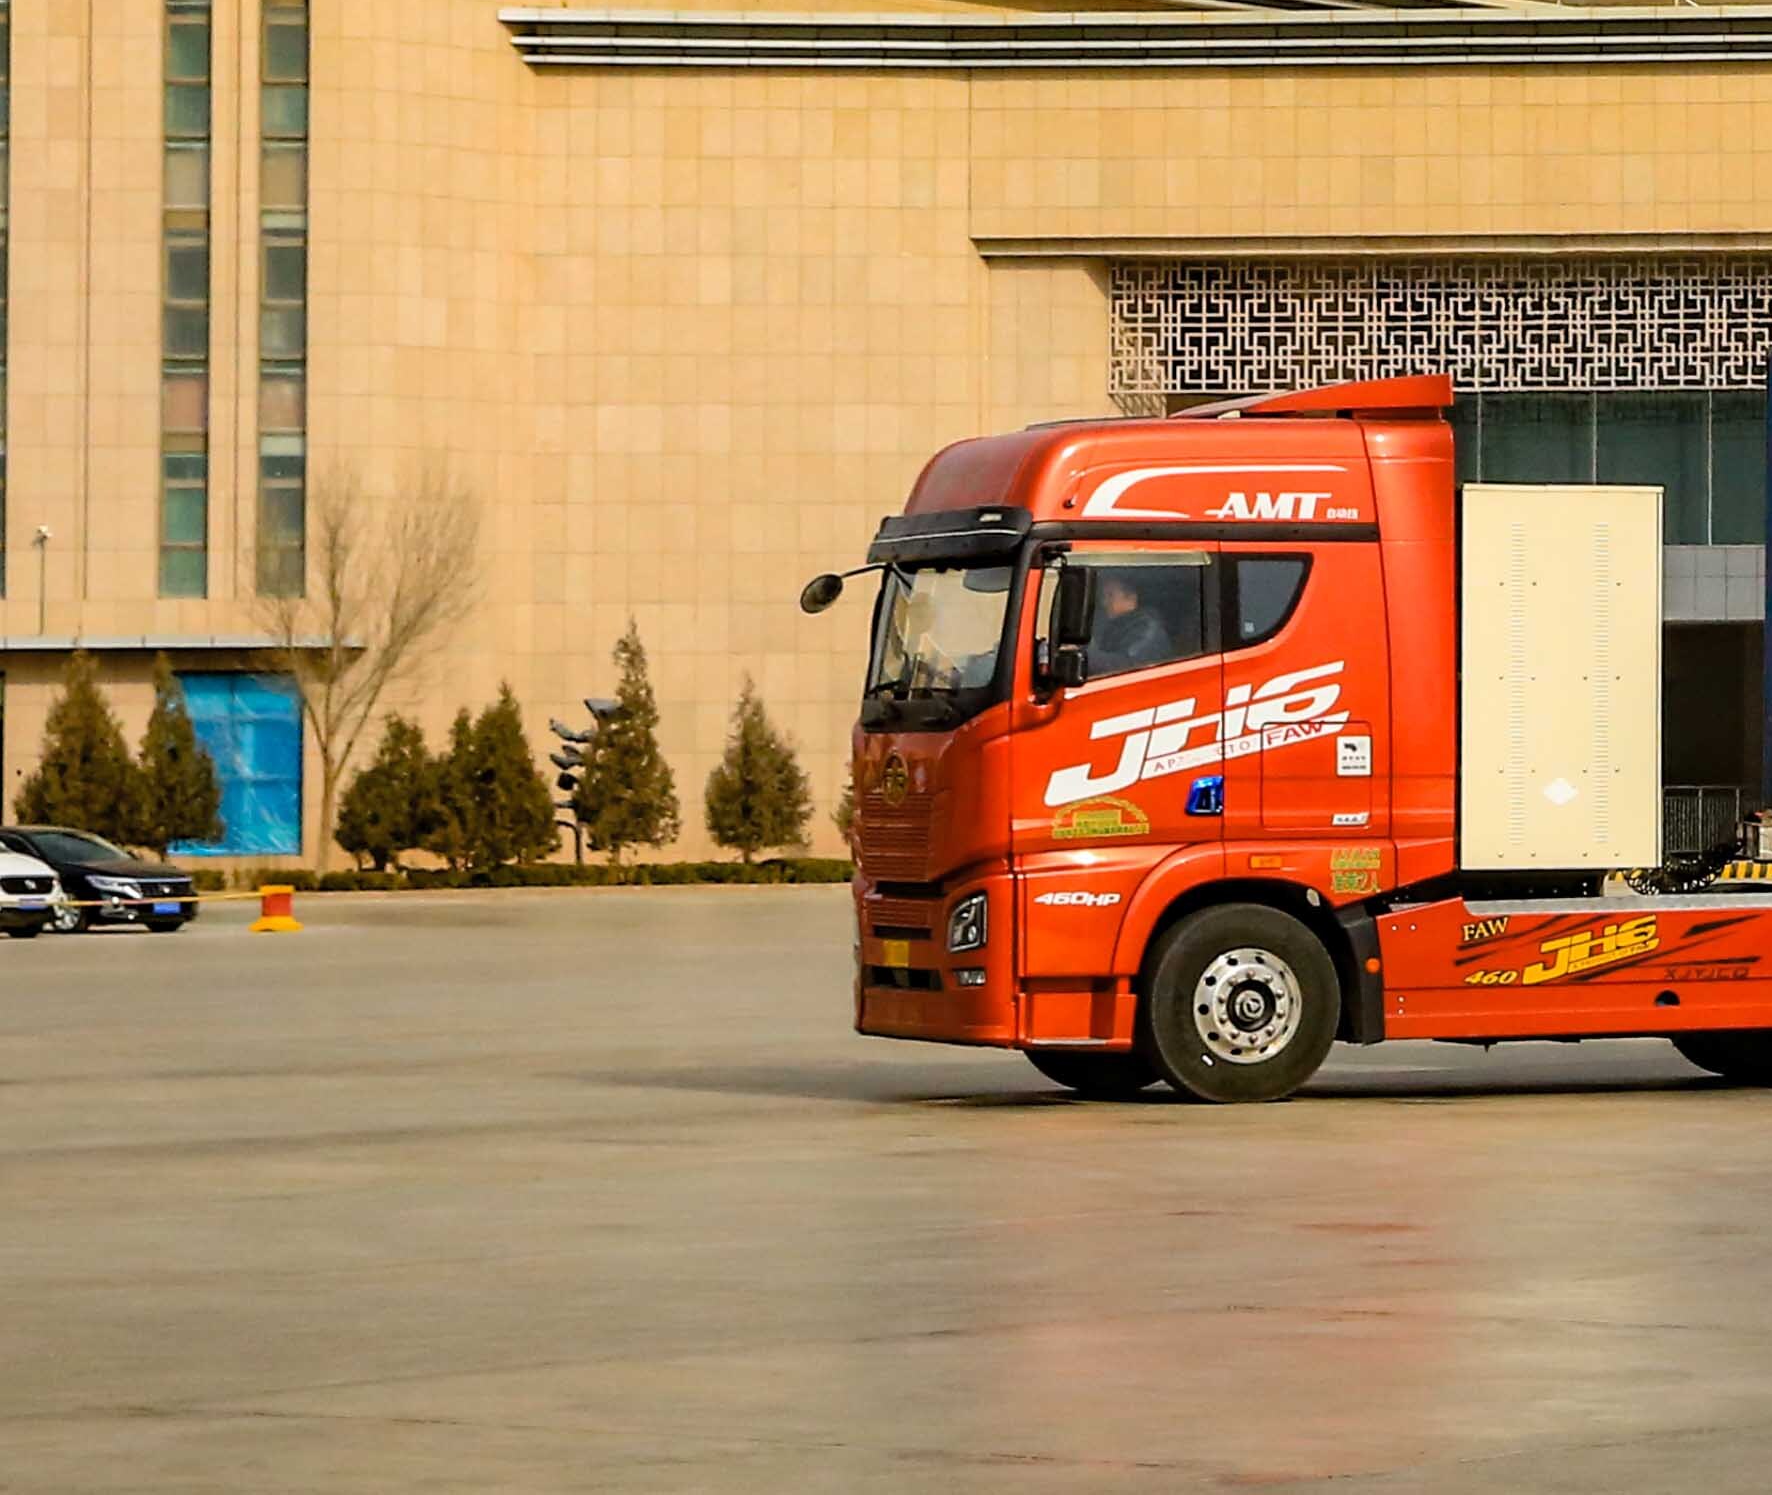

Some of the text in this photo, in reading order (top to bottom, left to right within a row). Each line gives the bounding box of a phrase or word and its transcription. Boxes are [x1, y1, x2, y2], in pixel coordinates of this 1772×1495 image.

[1204, 492, 1333, 520] AMT
[1044, 660, 1350, 807] JH6
[1266, 719, 1327, 747] FAW
[1034, 891, 1121, 907] 460HP
[1463, 916, 1509, 941] FAW
[1464, 970, 1518, 985] 460
